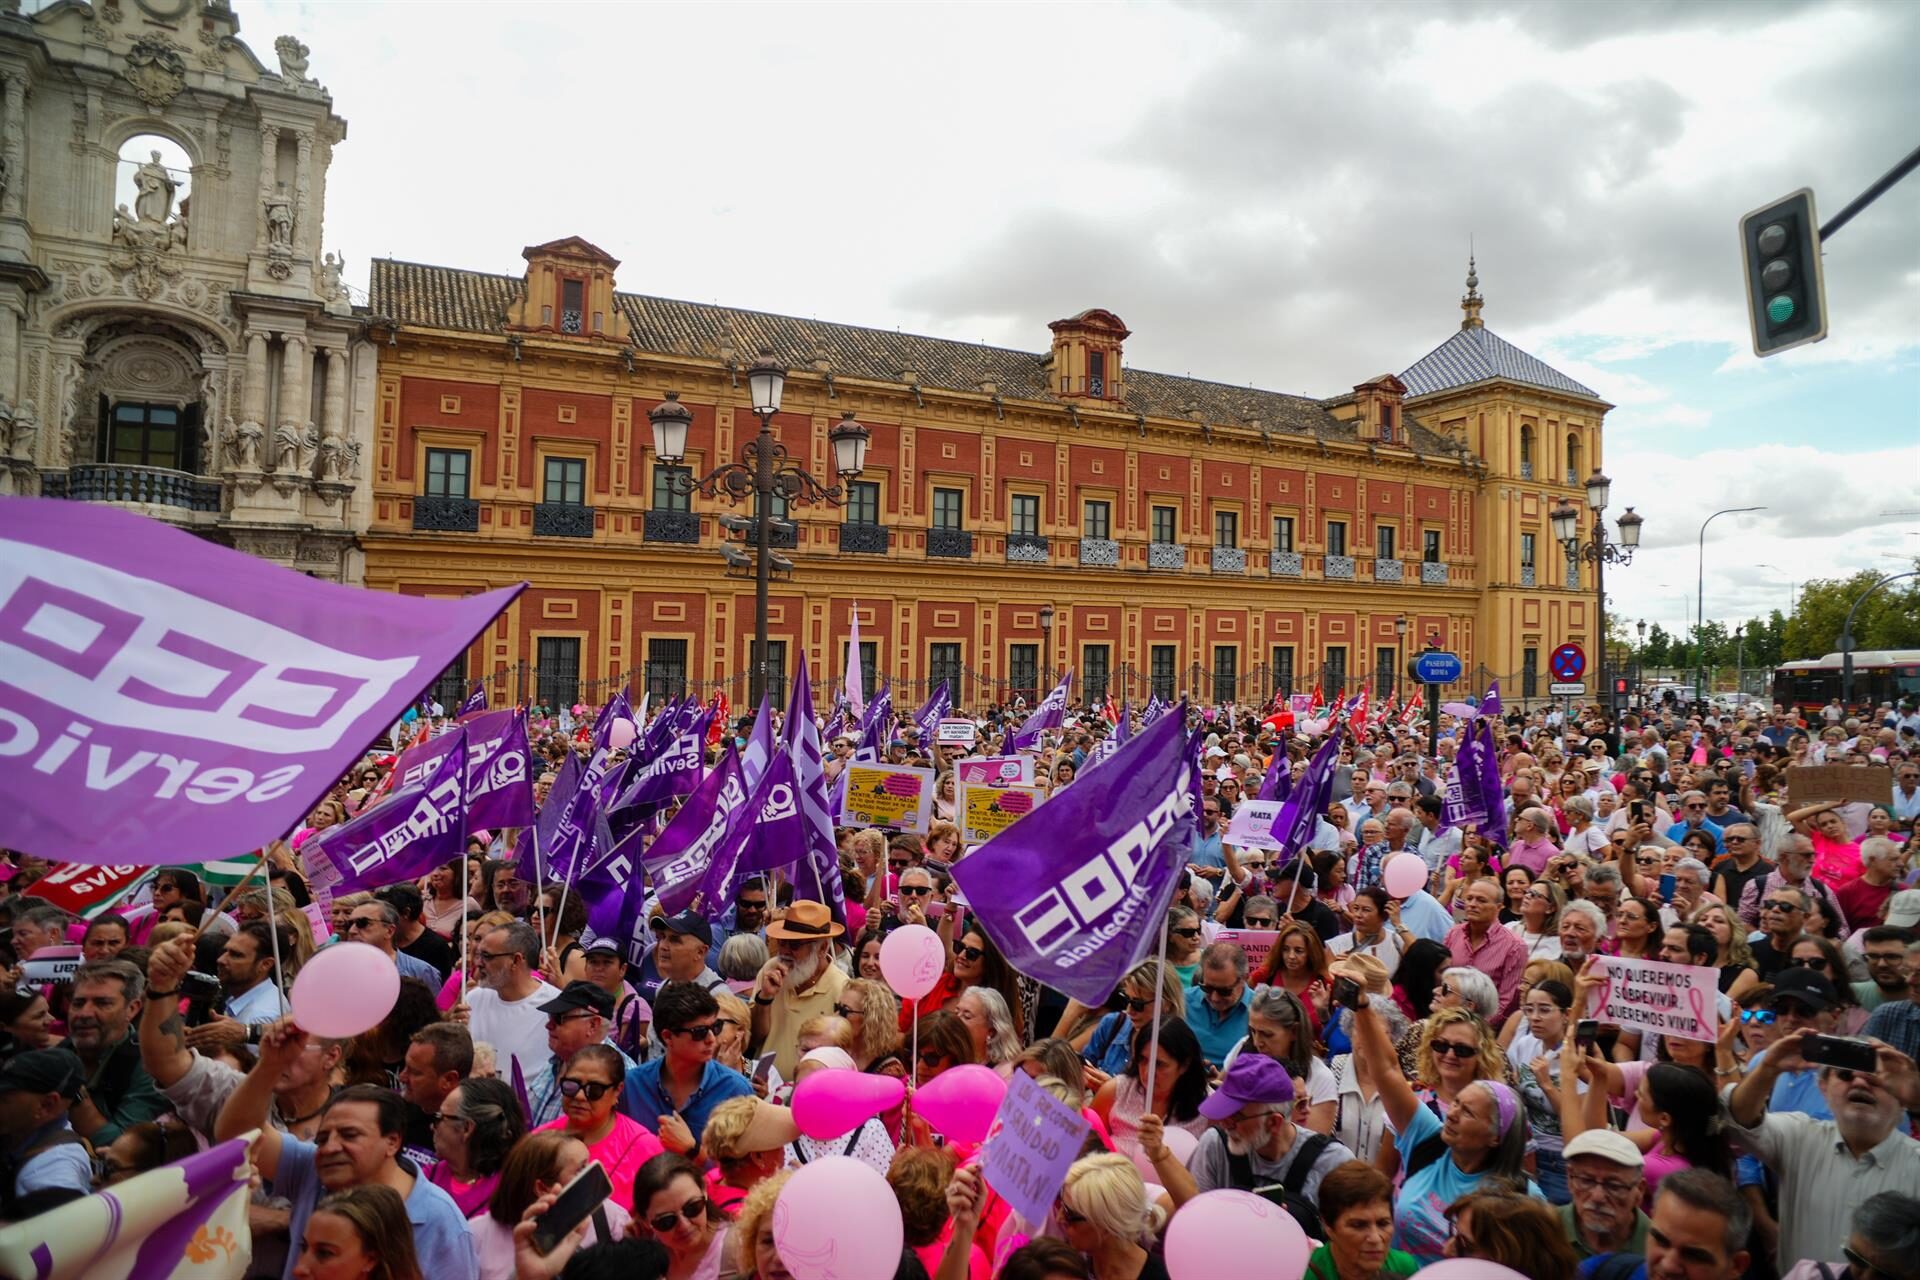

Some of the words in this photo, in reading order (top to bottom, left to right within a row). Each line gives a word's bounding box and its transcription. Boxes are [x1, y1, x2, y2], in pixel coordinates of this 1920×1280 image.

[1607, 966, 1623, 980] NO
[1625, 968, 1692, 989] QUEREMOS
[1606, 1003, 1665, 1027] QUEREMOS
[1667, 1015, 1699, 1033] VIVIR
[1010, 1107, 1060, 1161] SANIDAD
